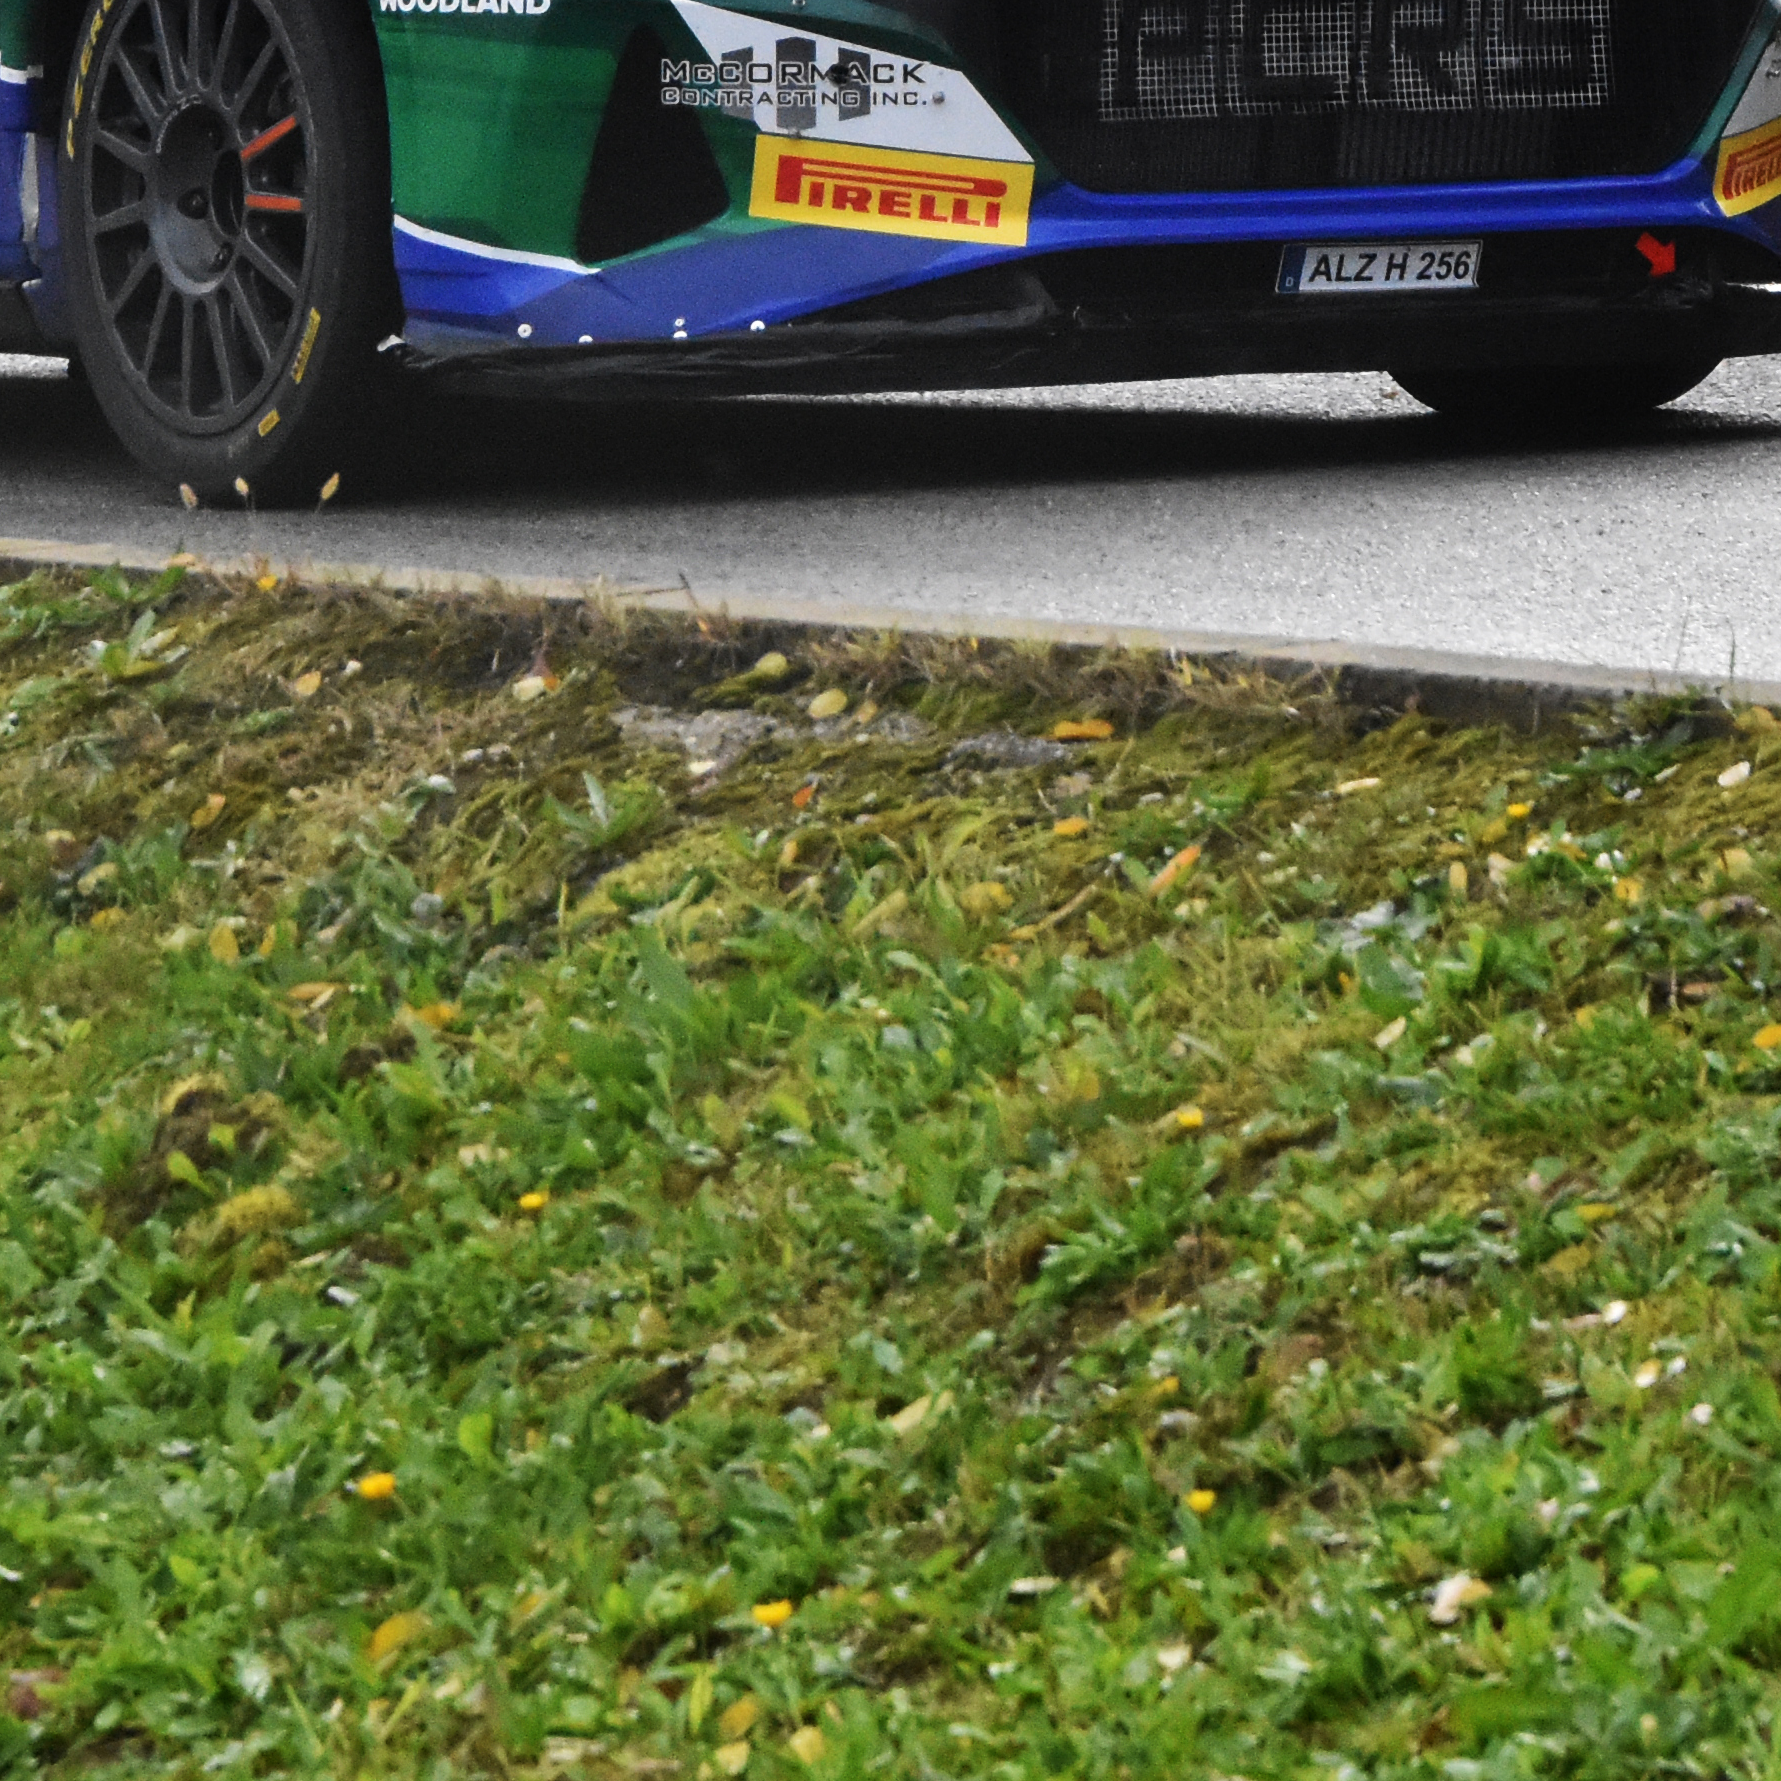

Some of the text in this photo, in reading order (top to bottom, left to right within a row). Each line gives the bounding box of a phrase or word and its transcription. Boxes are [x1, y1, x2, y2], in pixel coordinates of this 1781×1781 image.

[871, 90, 928, 107] INC.
[774, 154, 1008, 229] PIRELLI
[1308, 250, 1472, 282] ALZ H 256
